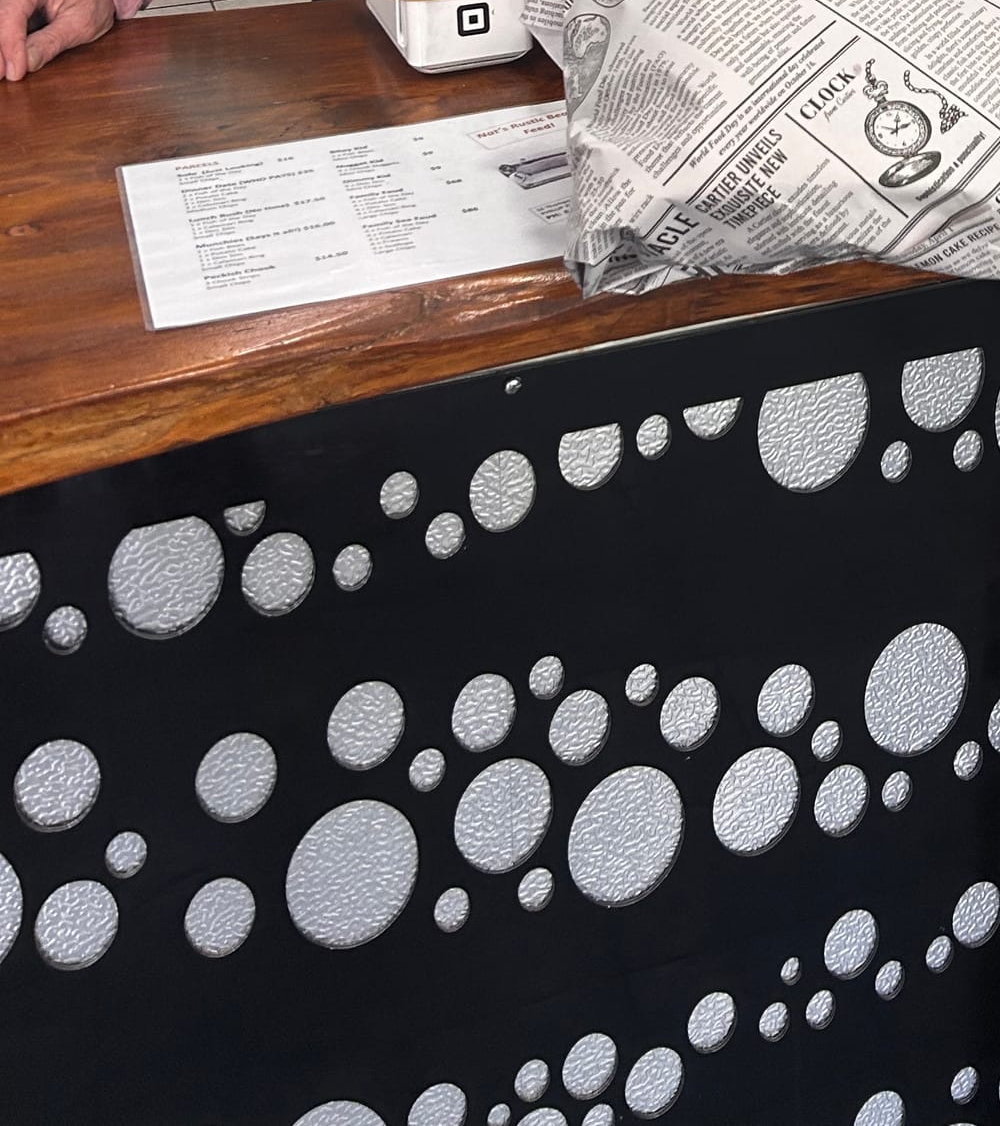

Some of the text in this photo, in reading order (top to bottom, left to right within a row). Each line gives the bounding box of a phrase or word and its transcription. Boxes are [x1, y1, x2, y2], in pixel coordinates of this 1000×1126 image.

[510, 117, 545, 130] Rustic
[687, 146, 711, 169] World
[707, 130, 726, 149] Food
[723, 117, 740, 134] Day
[750, 69, 789, 106] international
[786, 61, 799, 74] day
[796, 37, 825, 64] celebrated
[716, 137, 736, 156] every
[733, 123, 750, 140] year
[745, 94, 779, 125] worldwide
[783, 66, 807, 89] October
[800, 68, 855, 119] CLOCK
[823, 104, 841, 123] from
[647, 144, 684, 179] challenges
[689, 97, 729, 135] opportunities
[695, 127, 783, 214] CARTIER UNVEILS
[710, 148, 789, 221] EXQUISITE NEW
[723, 184, 783, 230] TIMEPIECE
[941, 238, 969, 258] CAKE
